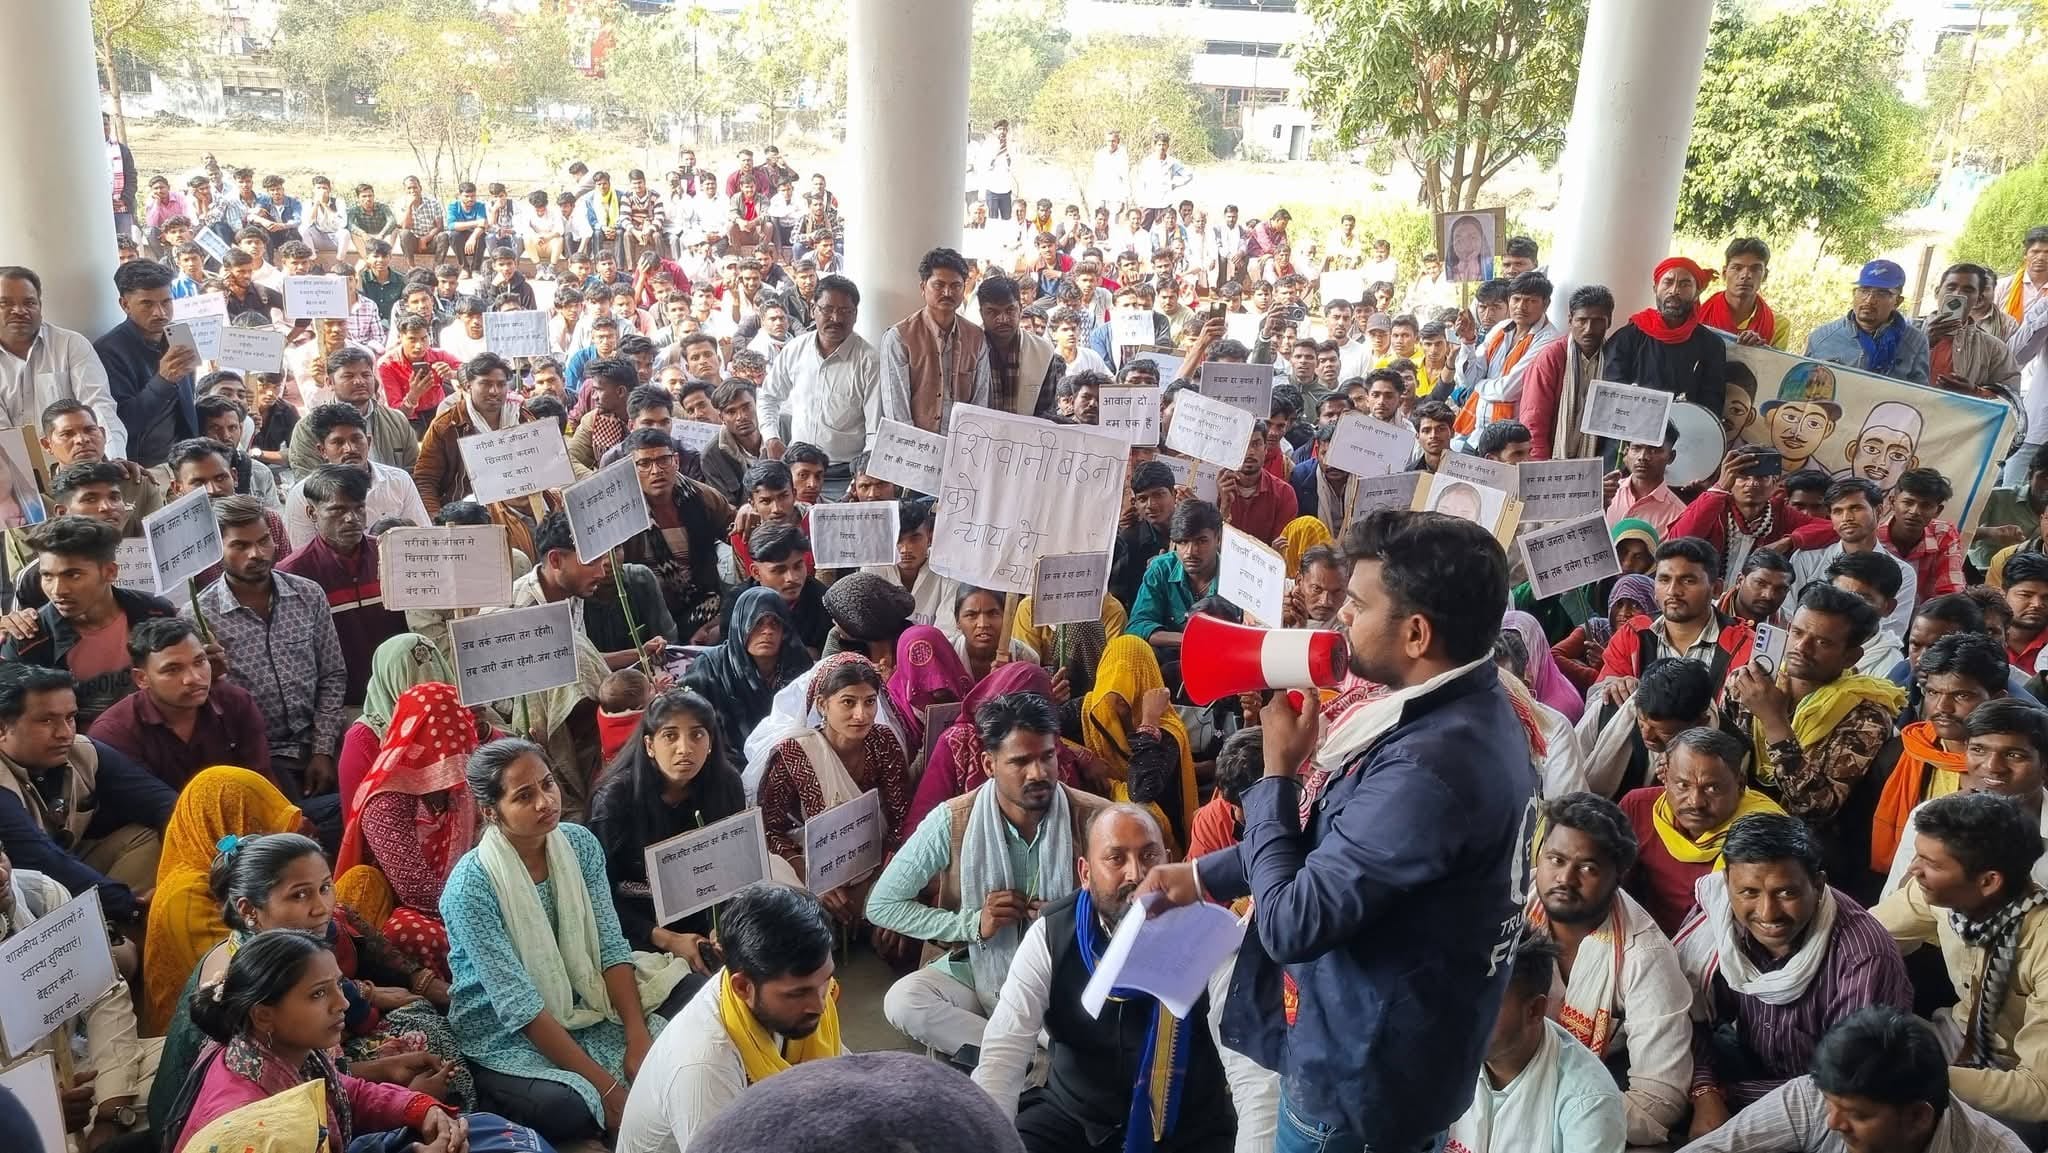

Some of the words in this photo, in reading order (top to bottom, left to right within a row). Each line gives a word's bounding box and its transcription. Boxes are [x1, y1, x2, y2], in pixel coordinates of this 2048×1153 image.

[1106, 419, 1120, 428] हम
[1125, 420, 1140, 428] एक
[949, 422, 1059, 482] शिवानी
[1056, 449, 1129, 489] बहन
[945, 472, 980, 519] को
[954, 521, 1009, 552] न्याय
[1019, 520, 1049, 553] दो
[1546, 534, 1566, 547] जनता
[420, 568, 440, 579] करो।
[420, 585, 440, 595] करो।
[462, 640, 474, 650] जब
[494, 633, 516, 645] जनता
[466, 668, 477, 678] तब
[481, 661, 497, 673] जारी
[6, 935, 39, 964] शासकीय
[40, 912, 77, 943] अस्पतालों
[36, 978, 58, 1001] बेहतर
[42, 1004, 65, 1026] बेहतर
